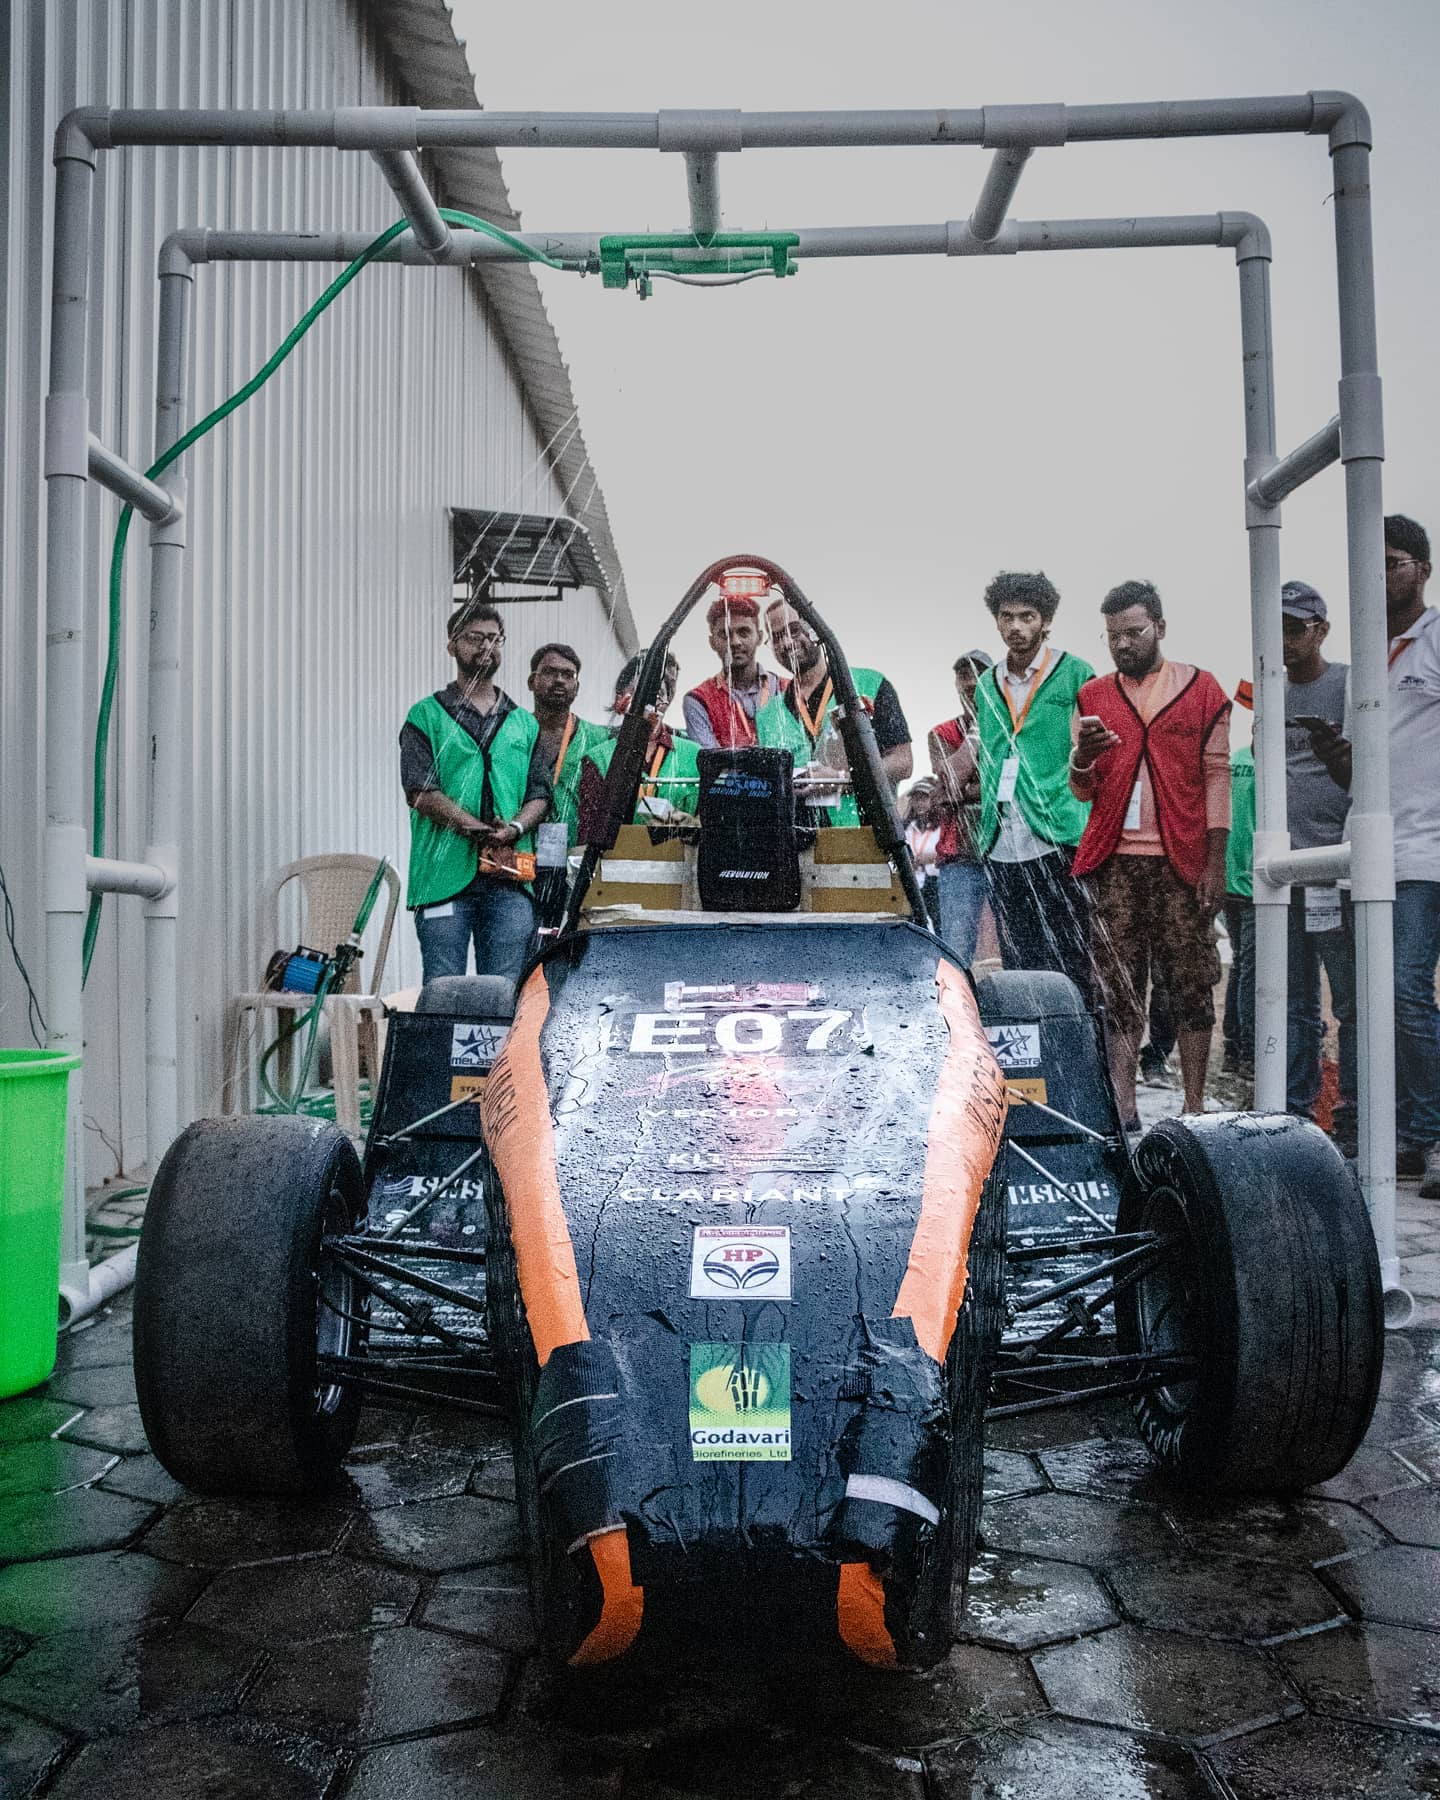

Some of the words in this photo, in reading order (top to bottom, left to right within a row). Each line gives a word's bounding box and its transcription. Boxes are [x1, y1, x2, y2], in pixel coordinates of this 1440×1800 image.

[718, 869, 770, 880] #EVOLUTION
[628, 1010, 854, 1053] E07
[643, 1108, 800, 1117] VECTOR
[619, 1188, 853, 1202] CLARIANT
[722, 1249, 764, 1262] HP
[692, 1429, 790, 1445] Godavari
[769, 1449, 788, 1458] Ltd
